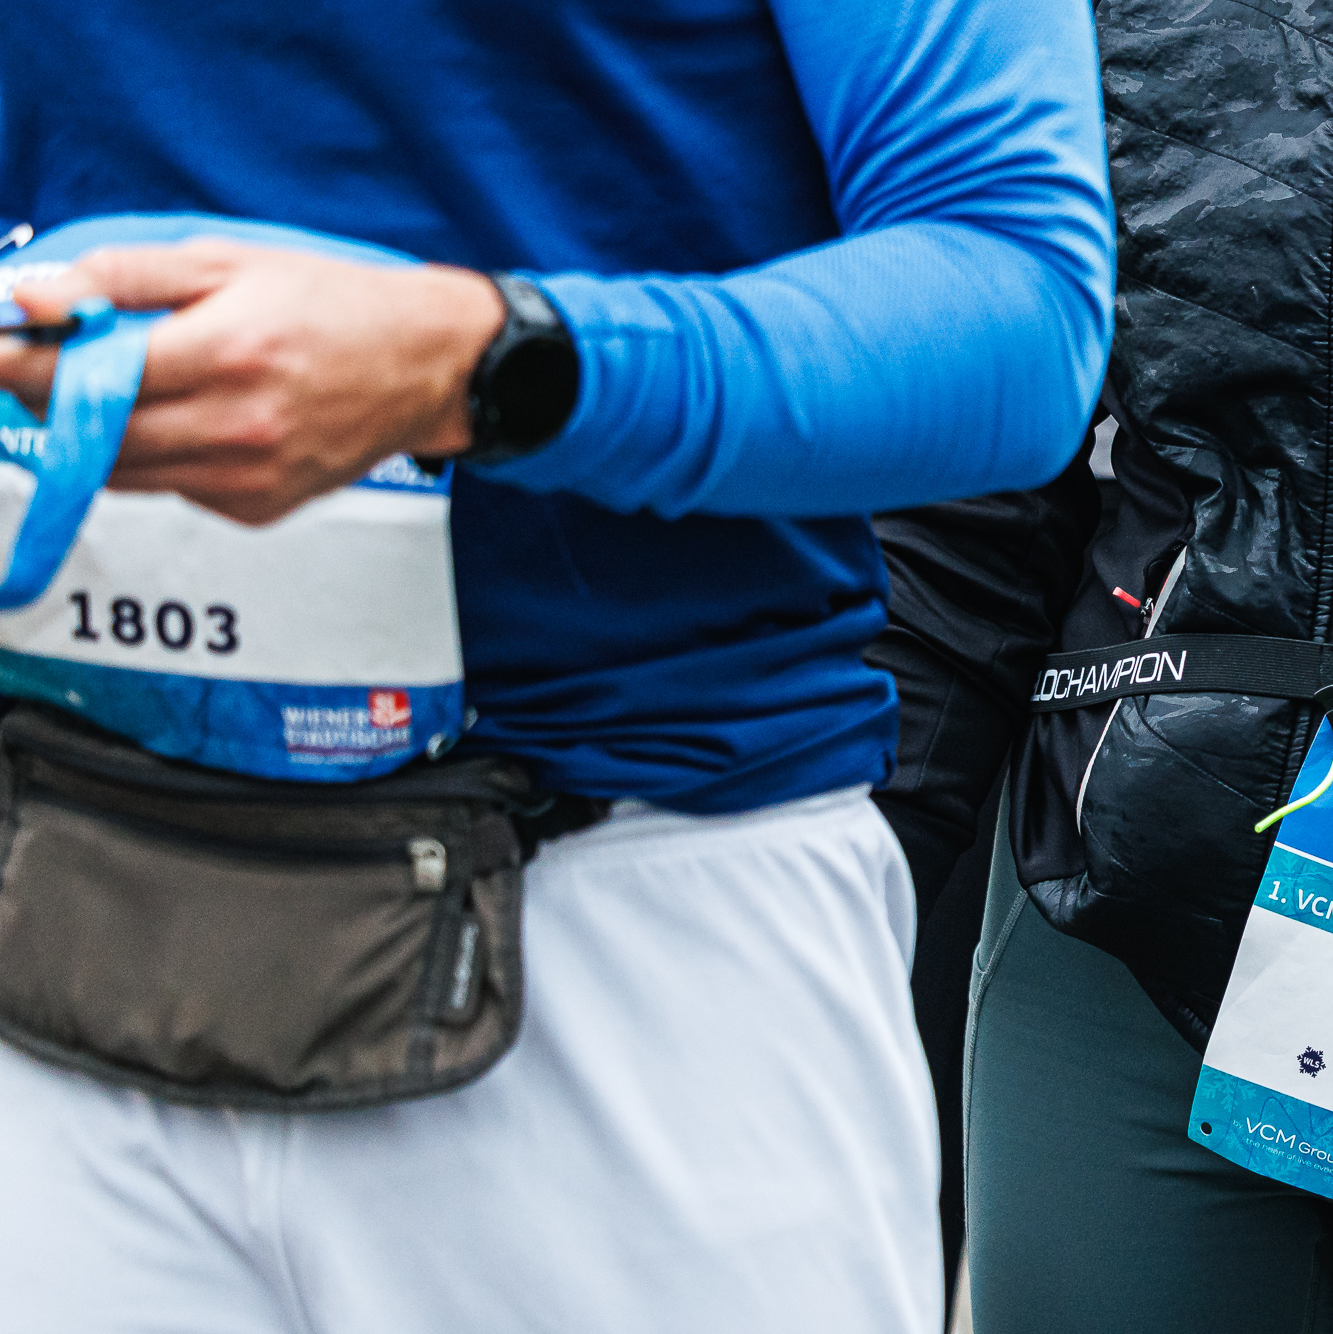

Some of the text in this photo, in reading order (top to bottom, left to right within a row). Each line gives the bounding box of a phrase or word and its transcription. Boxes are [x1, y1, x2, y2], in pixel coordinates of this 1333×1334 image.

[68, 590, 240, 655] 1803
[1267, 880, 1288, 904] 1.
[1246, 1116, 1297, 1149] VCM
[1245, 1138, 1261, 1149] the
[1286, 1153, 1297, 1161] of
